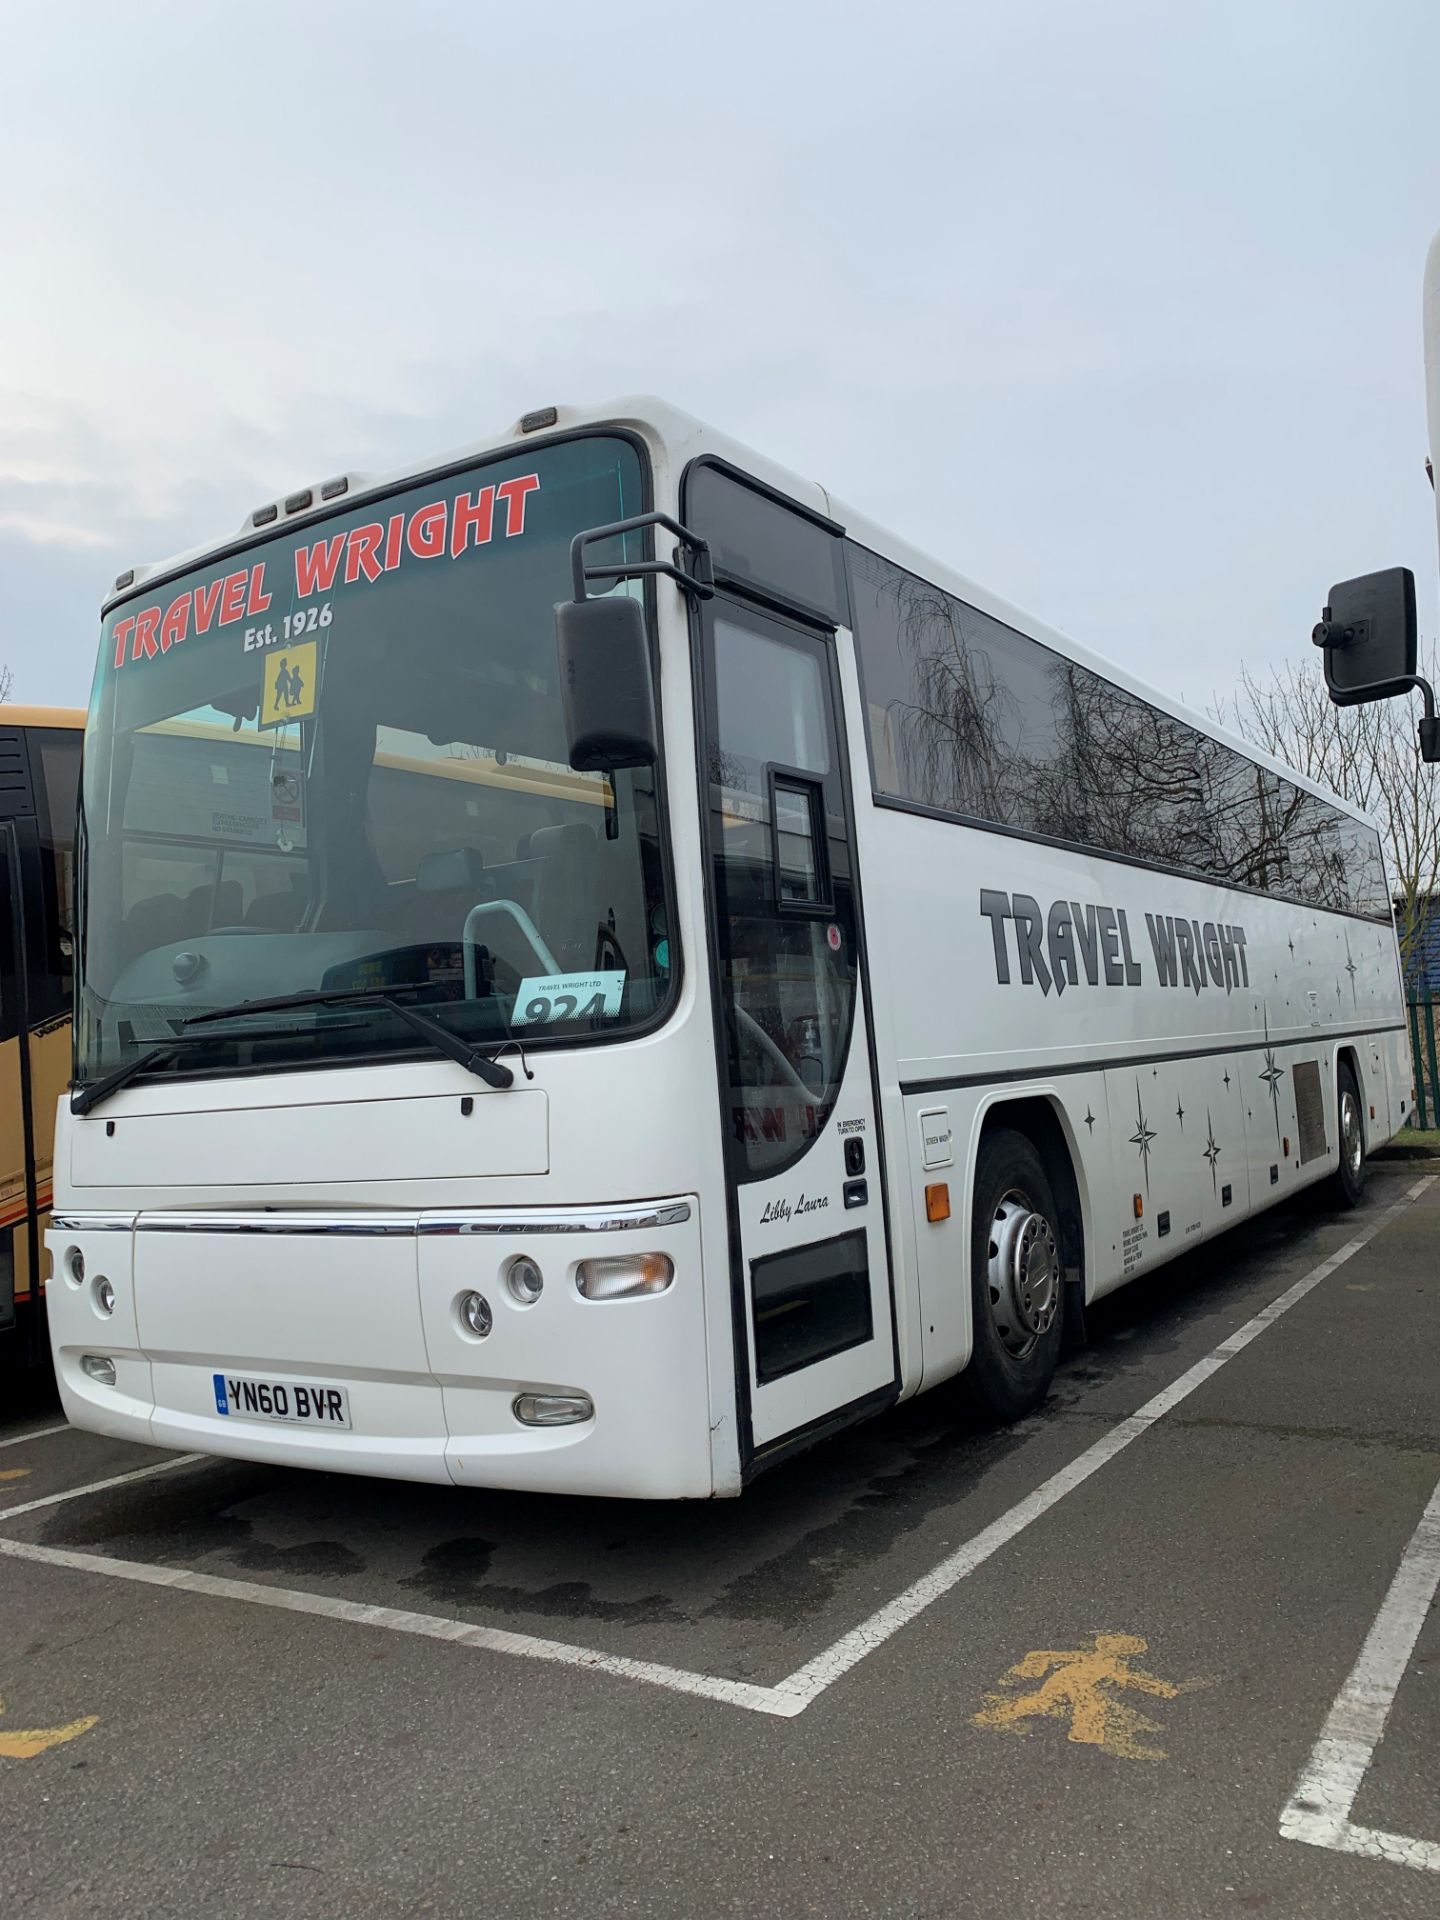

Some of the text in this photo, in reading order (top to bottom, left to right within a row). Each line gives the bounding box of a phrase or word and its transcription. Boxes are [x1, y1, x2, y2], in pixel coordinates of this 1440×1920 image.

[112, 473, 541, 669] TRAVEL WRIGHT
[244, 602, 334, 653] Est. 1926
[980, 888, 1249, 997] TRAVEL WRIGHT
[525, 992, 607, 1023] 924
[760, 1193, 829, 1224] Libby Laura
[228, 1380, 344, 1422] YN60 BVR
